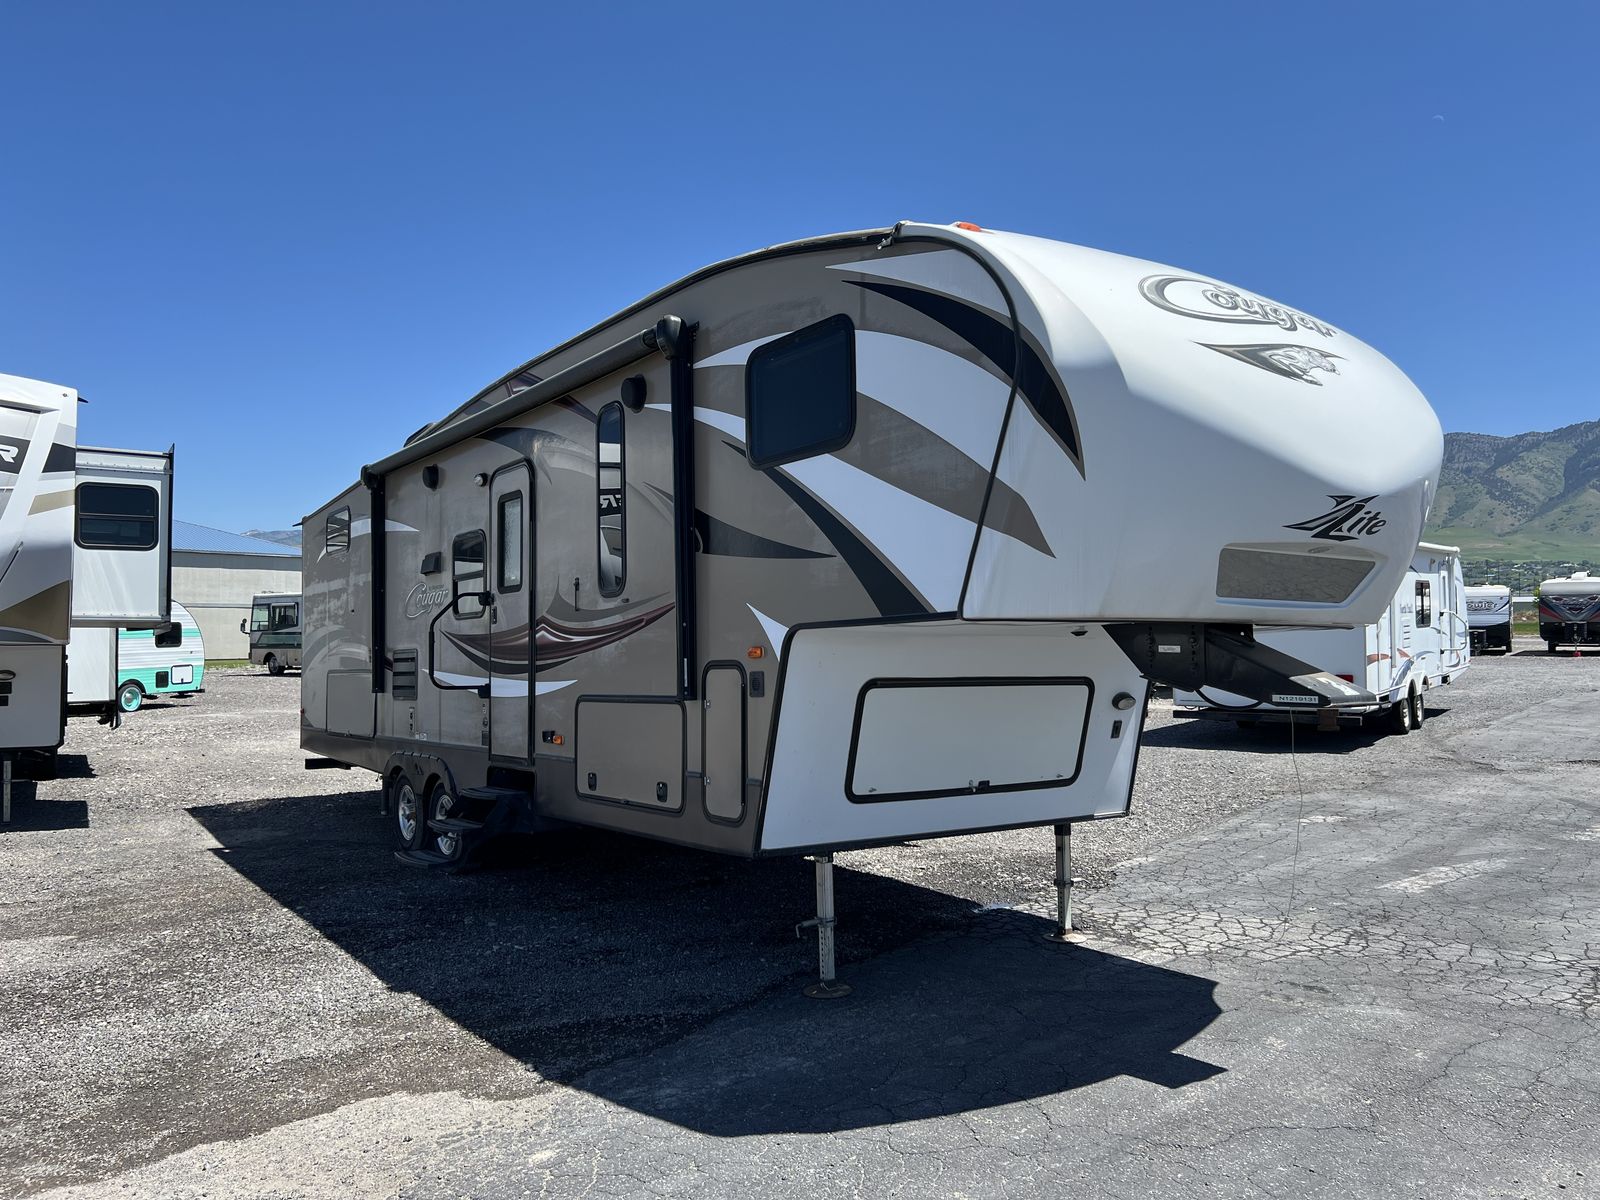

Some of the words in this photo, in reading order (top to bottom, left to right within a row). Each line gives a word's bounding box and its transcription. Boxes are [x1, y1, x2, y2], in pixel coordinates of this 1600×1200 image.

[1138, 274, 1338, 337] Cougar
[405, 583, 449, 618] Cougar
[1466, 600, 1498, 611] owler
